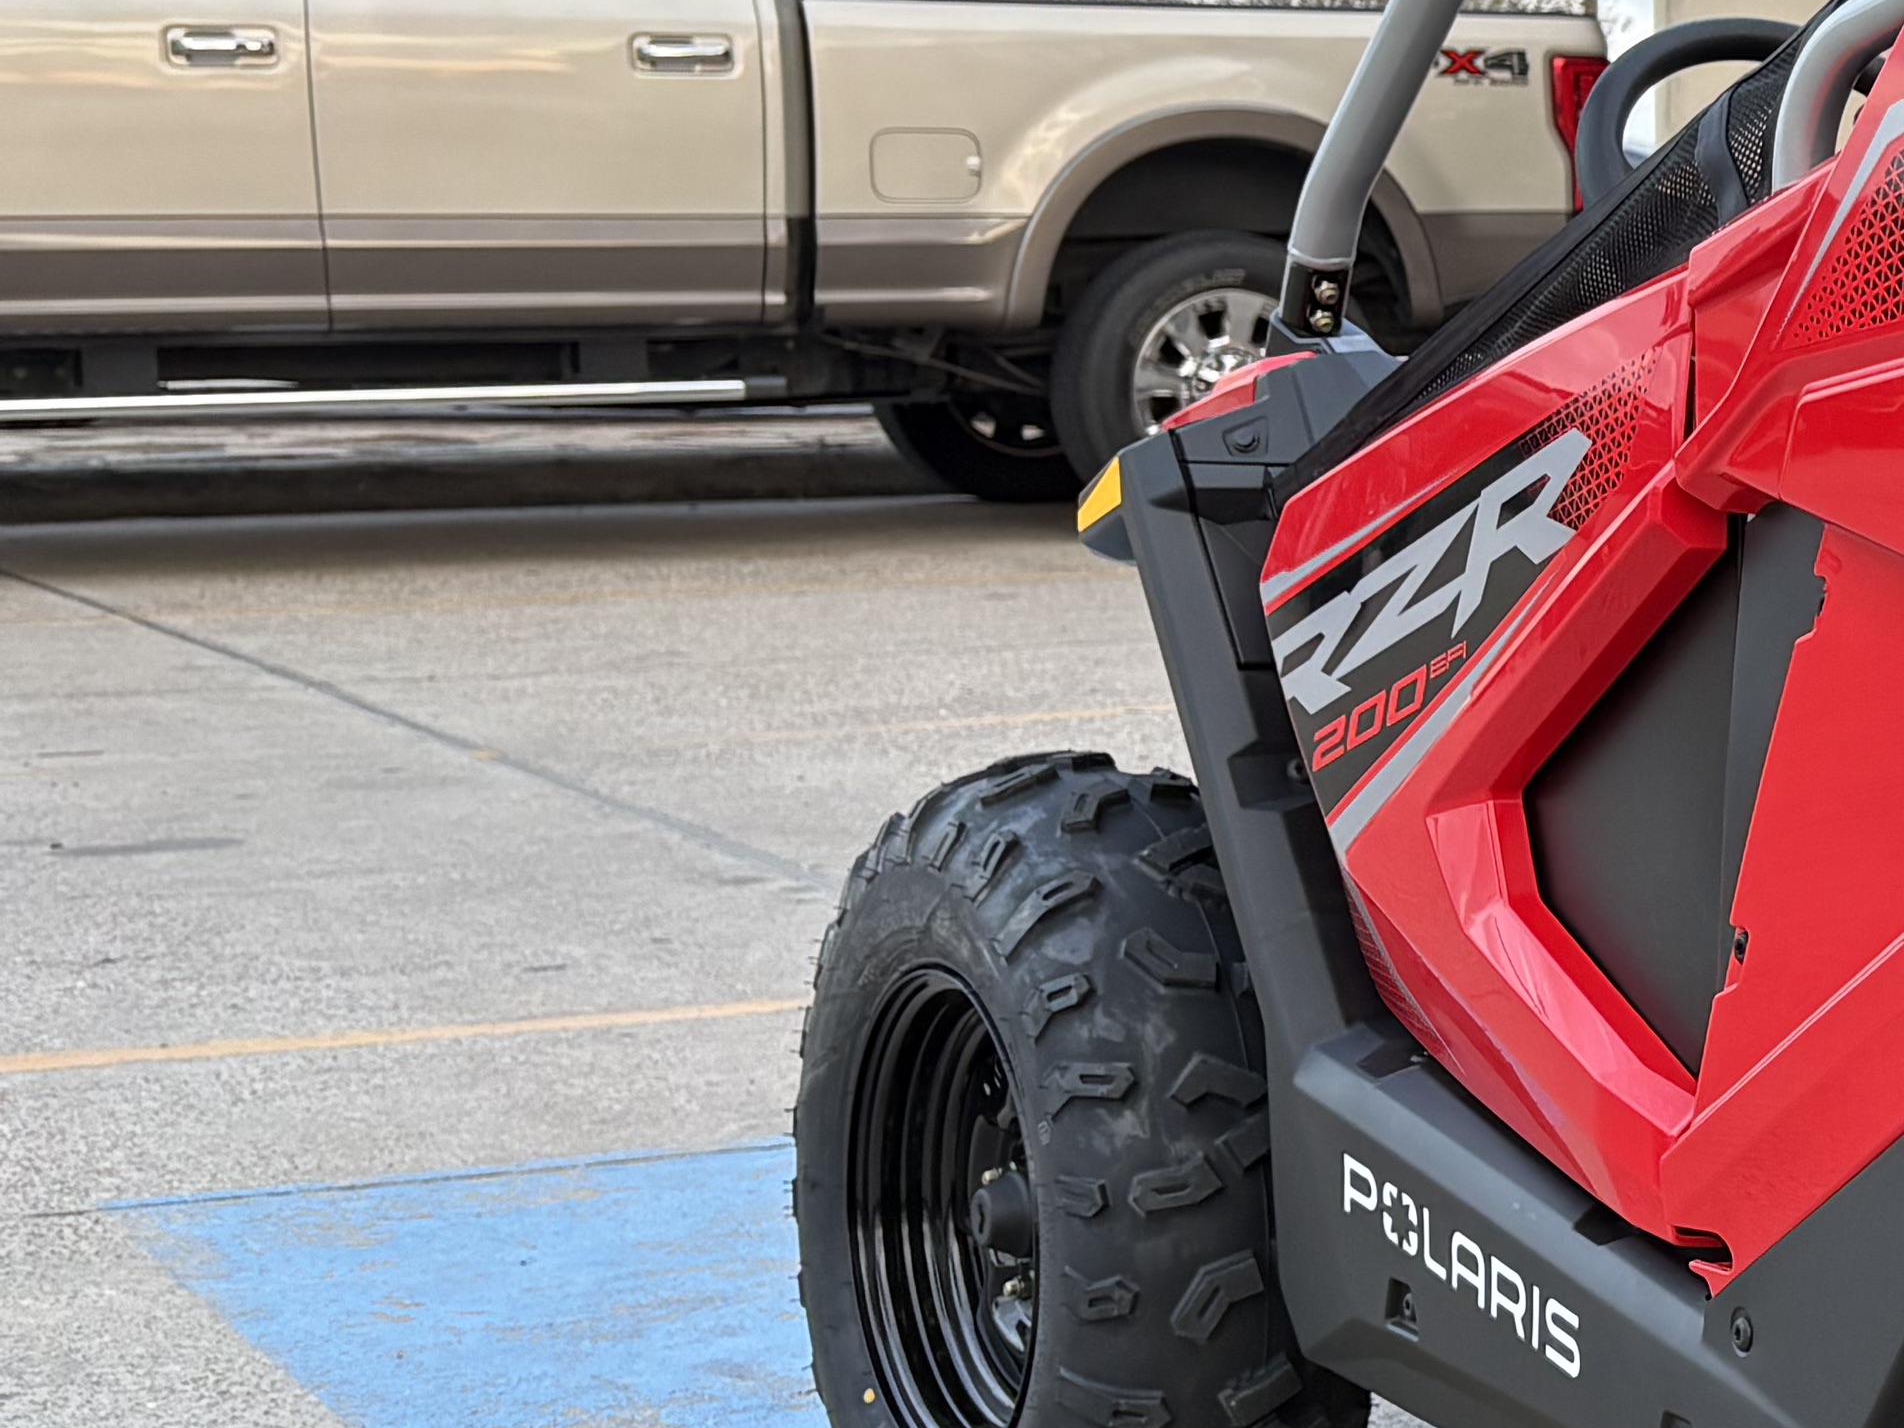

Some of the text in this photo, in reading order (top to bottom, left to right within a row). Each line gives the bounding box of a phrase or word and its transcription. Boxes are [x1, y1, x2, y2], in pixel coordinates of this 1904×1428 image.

[1271, 428, 1592, 715] RZR
[1312, 664, 1427, 772] 200
[1342, 1152, 1582, 1379] POLARIS
